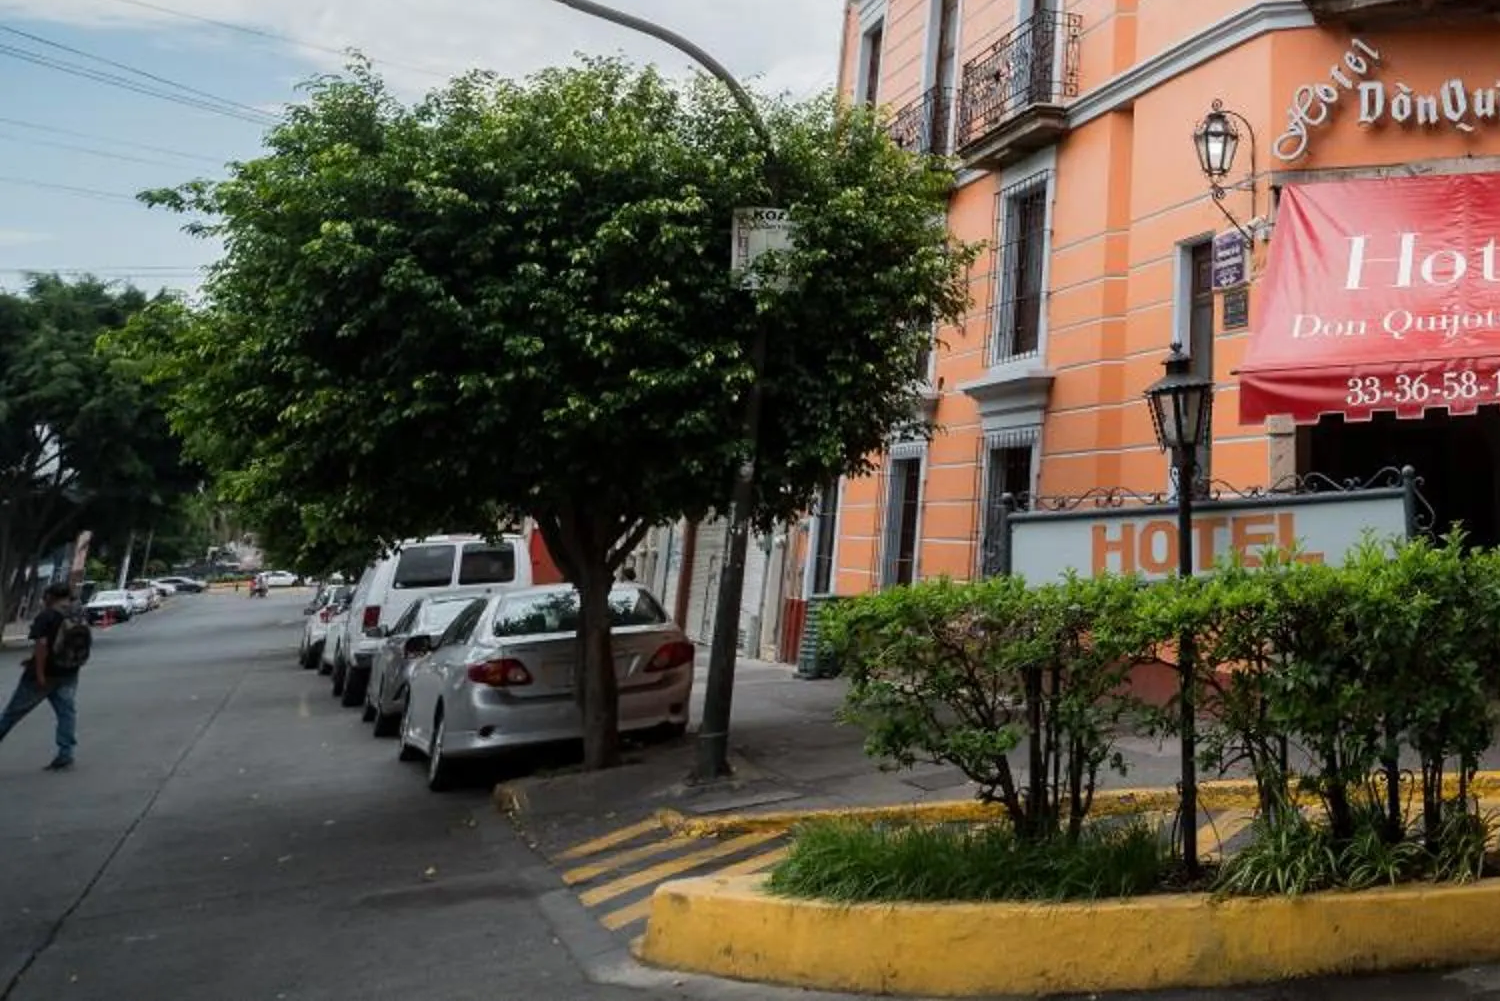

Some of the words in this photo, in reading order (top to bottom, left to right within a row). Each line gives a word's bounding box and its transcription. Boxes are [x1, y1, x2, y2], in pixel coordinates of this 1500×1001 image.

[1273, 38, 1380, 161] Hotel
[1292, 313, 1367, 339] Don
[1092, 512, 1324, 578] HOTEL
